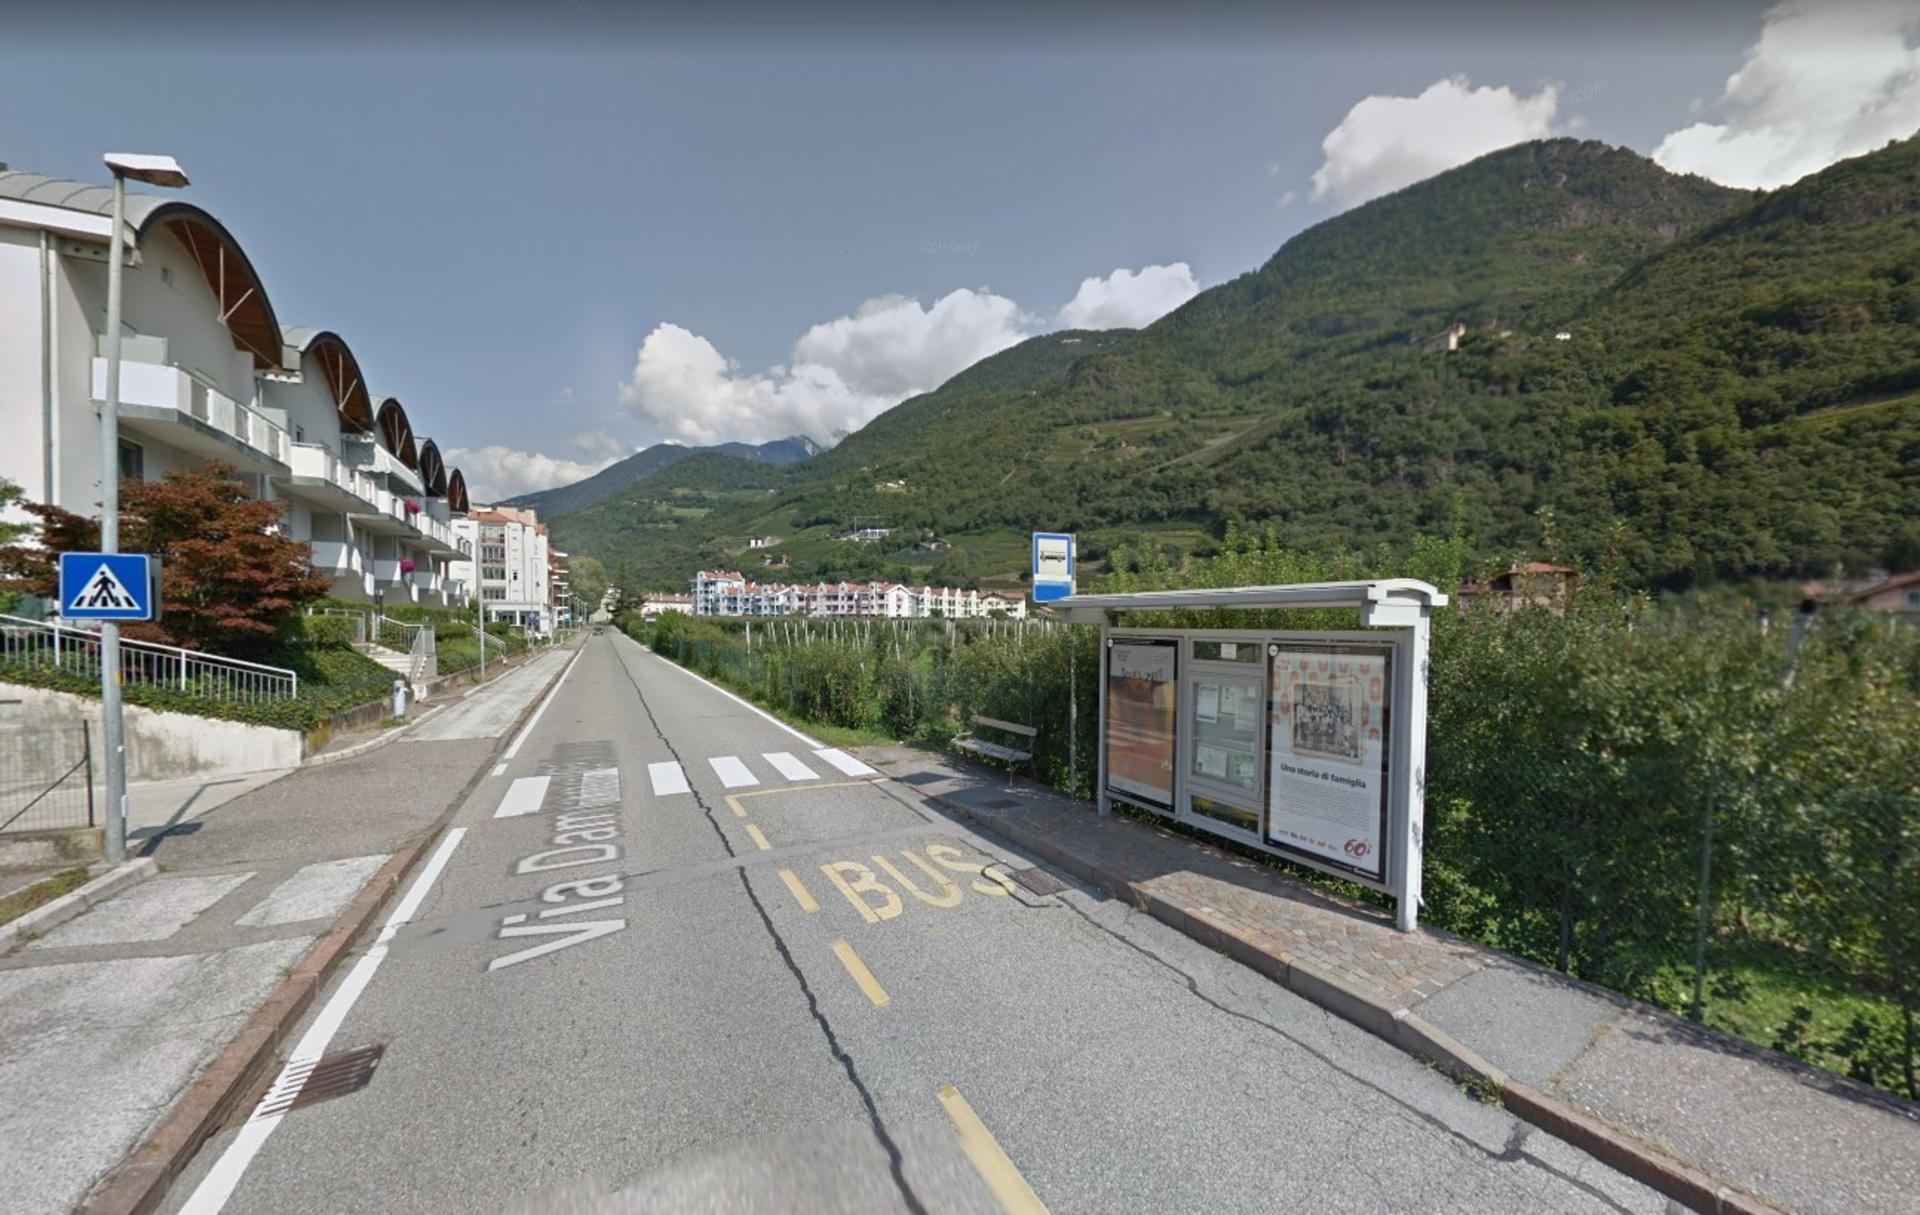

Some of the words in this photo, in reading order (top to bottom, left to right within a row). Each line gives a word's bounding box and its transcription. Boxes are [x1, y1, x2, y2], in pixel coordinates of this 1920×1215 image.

[1281, 763, 1296, 773] Una
[1297, 767, 1319, 778] storia
[1321, 771, 1329, 780] di
[1331, 773, 1367, 789] famiglia
[1344, 838, 1367, 857] 60
[820, 845, 1015, 923] BUS
